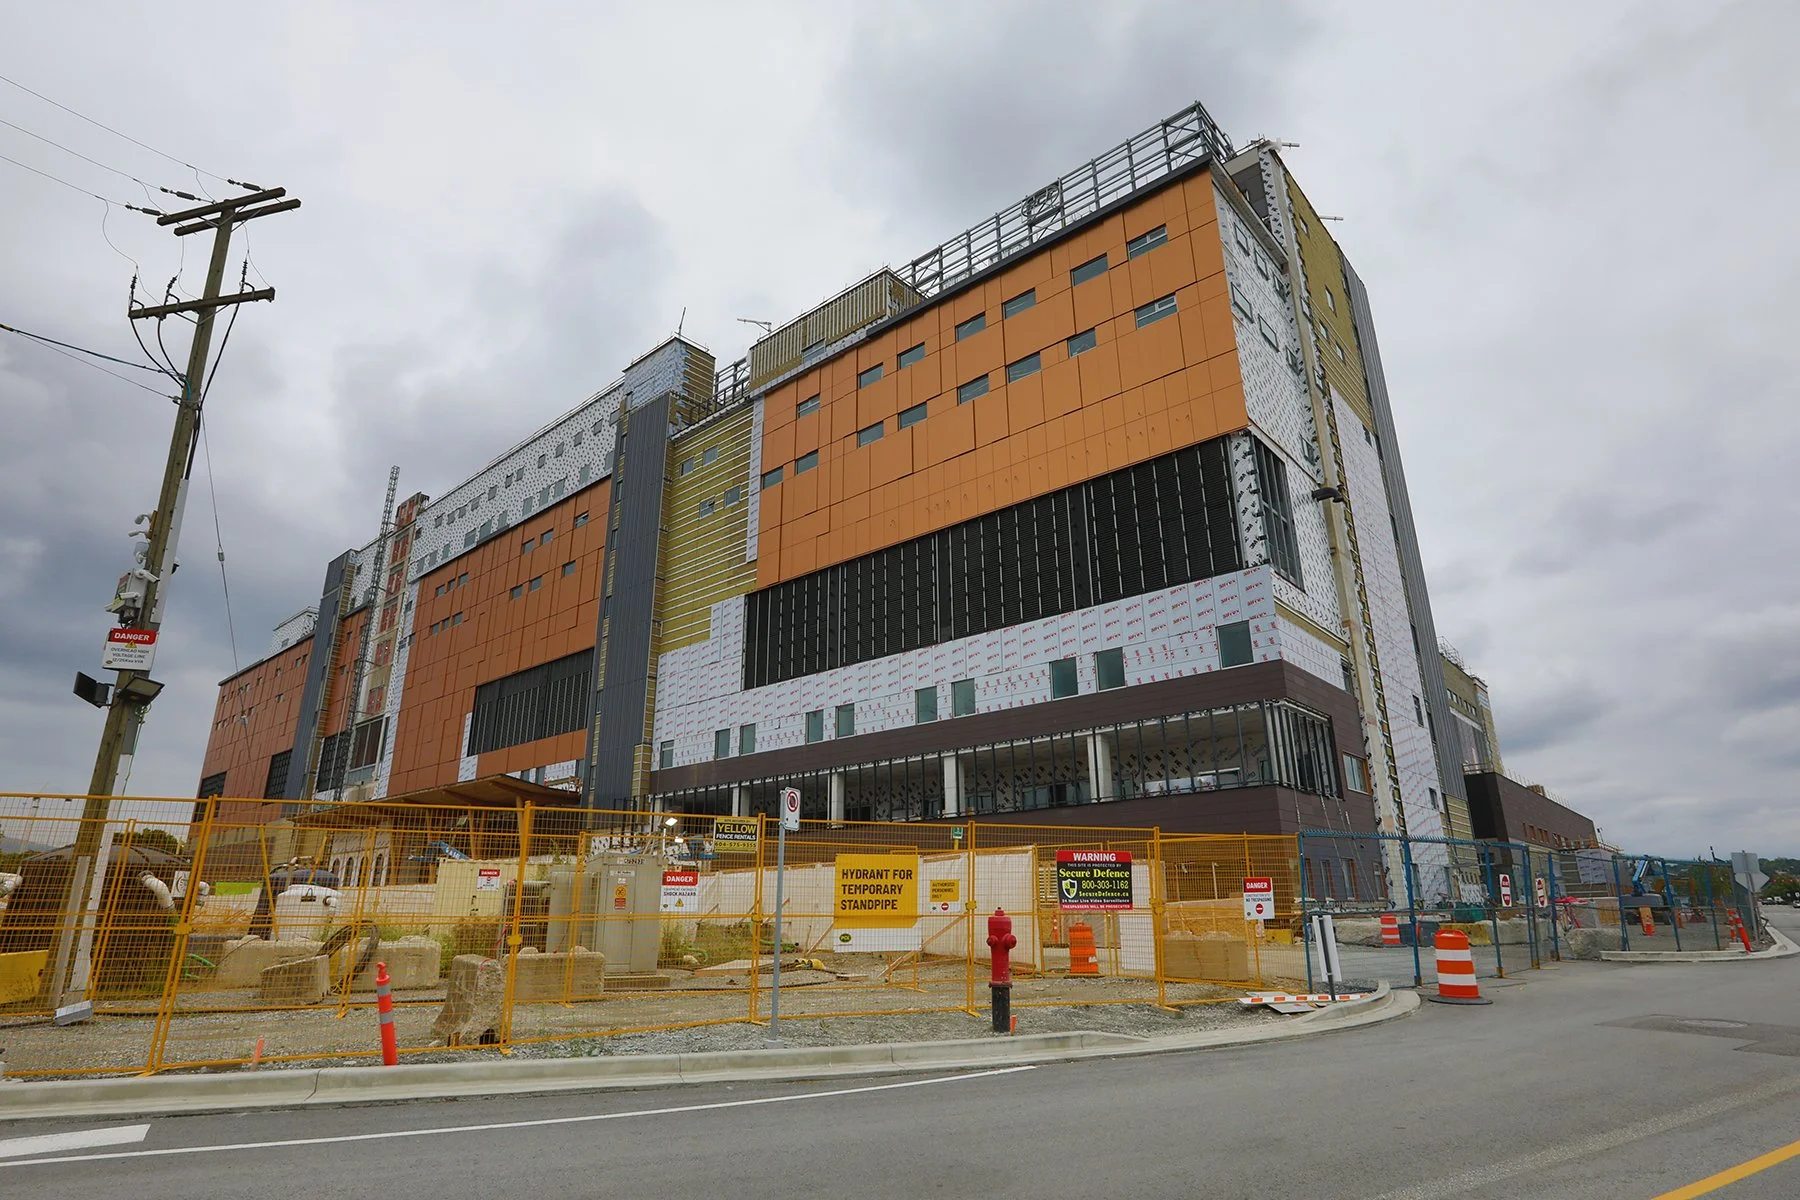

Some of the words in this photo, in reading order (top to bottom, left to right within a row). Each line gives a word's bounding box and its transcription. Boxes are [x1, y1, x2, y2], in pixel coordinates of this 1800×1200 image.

[114, 632, 150, 641] DANGER
[717, 823, 757, 834] YELLOW
[1073, 852, 1117, 861] WARNING
[841, 868, 890, 880] HYDRANT
[892, 869, 913, 880] FOR
[1059, 868, 1091, 878] Secure
[1093, 868, 1130, 878] Defence
[666, 875, 694, 883] DANGER
[841, 884, 904, 895] TEMPORARY
[1081, 880, 1129, 889] 800-303-1162
[840, 899, 898, 910] STANDPIPE
